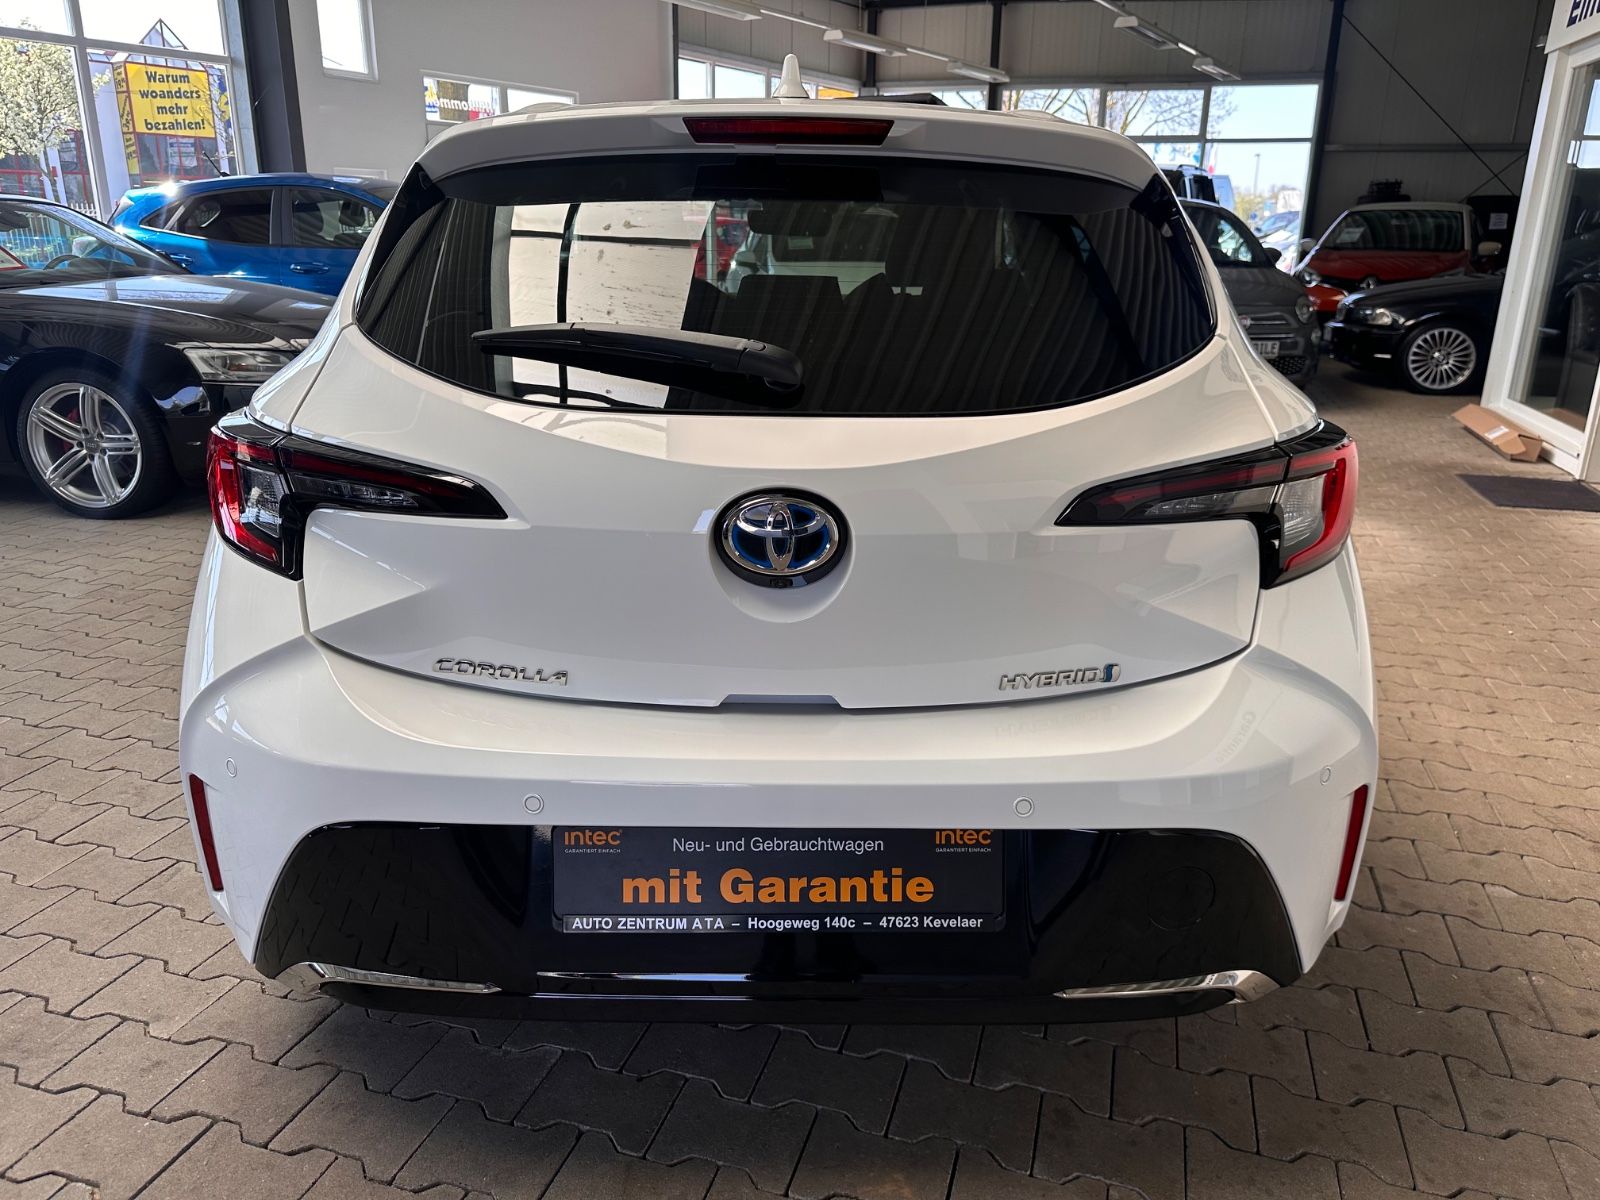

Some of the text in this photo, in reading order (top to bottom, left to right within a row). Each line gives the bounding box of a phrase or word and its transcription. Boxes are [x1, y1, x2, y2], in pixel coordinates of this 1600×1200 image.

[145, 70, 190, 84] Warum
[139, 87, 201, 99] woanders
[156, 102, 188, 115] mehr
[144, 118, 206, 131] bezahlen!
[432, 657, 569, 686] COROLLA
[998, 667, 1102, 691] HYBRID
[564, 829, 621, 845] intec
[935, 829, 992, 845] intec
[672, 837, 885, 855] Neu- und Gebrauchtwagen
[622, 867, 936, 904] mit Garantie
[572, 917, 613, 930] AUTO
[617, 917, 687, 930] ZENTRUM
[747, 916, 820, 932] Hoogeweg
[824, 916, 856, 929] 140c
[879, 916, 920, 928] 47623
[923, 915, 984, 928] Kevelaer
